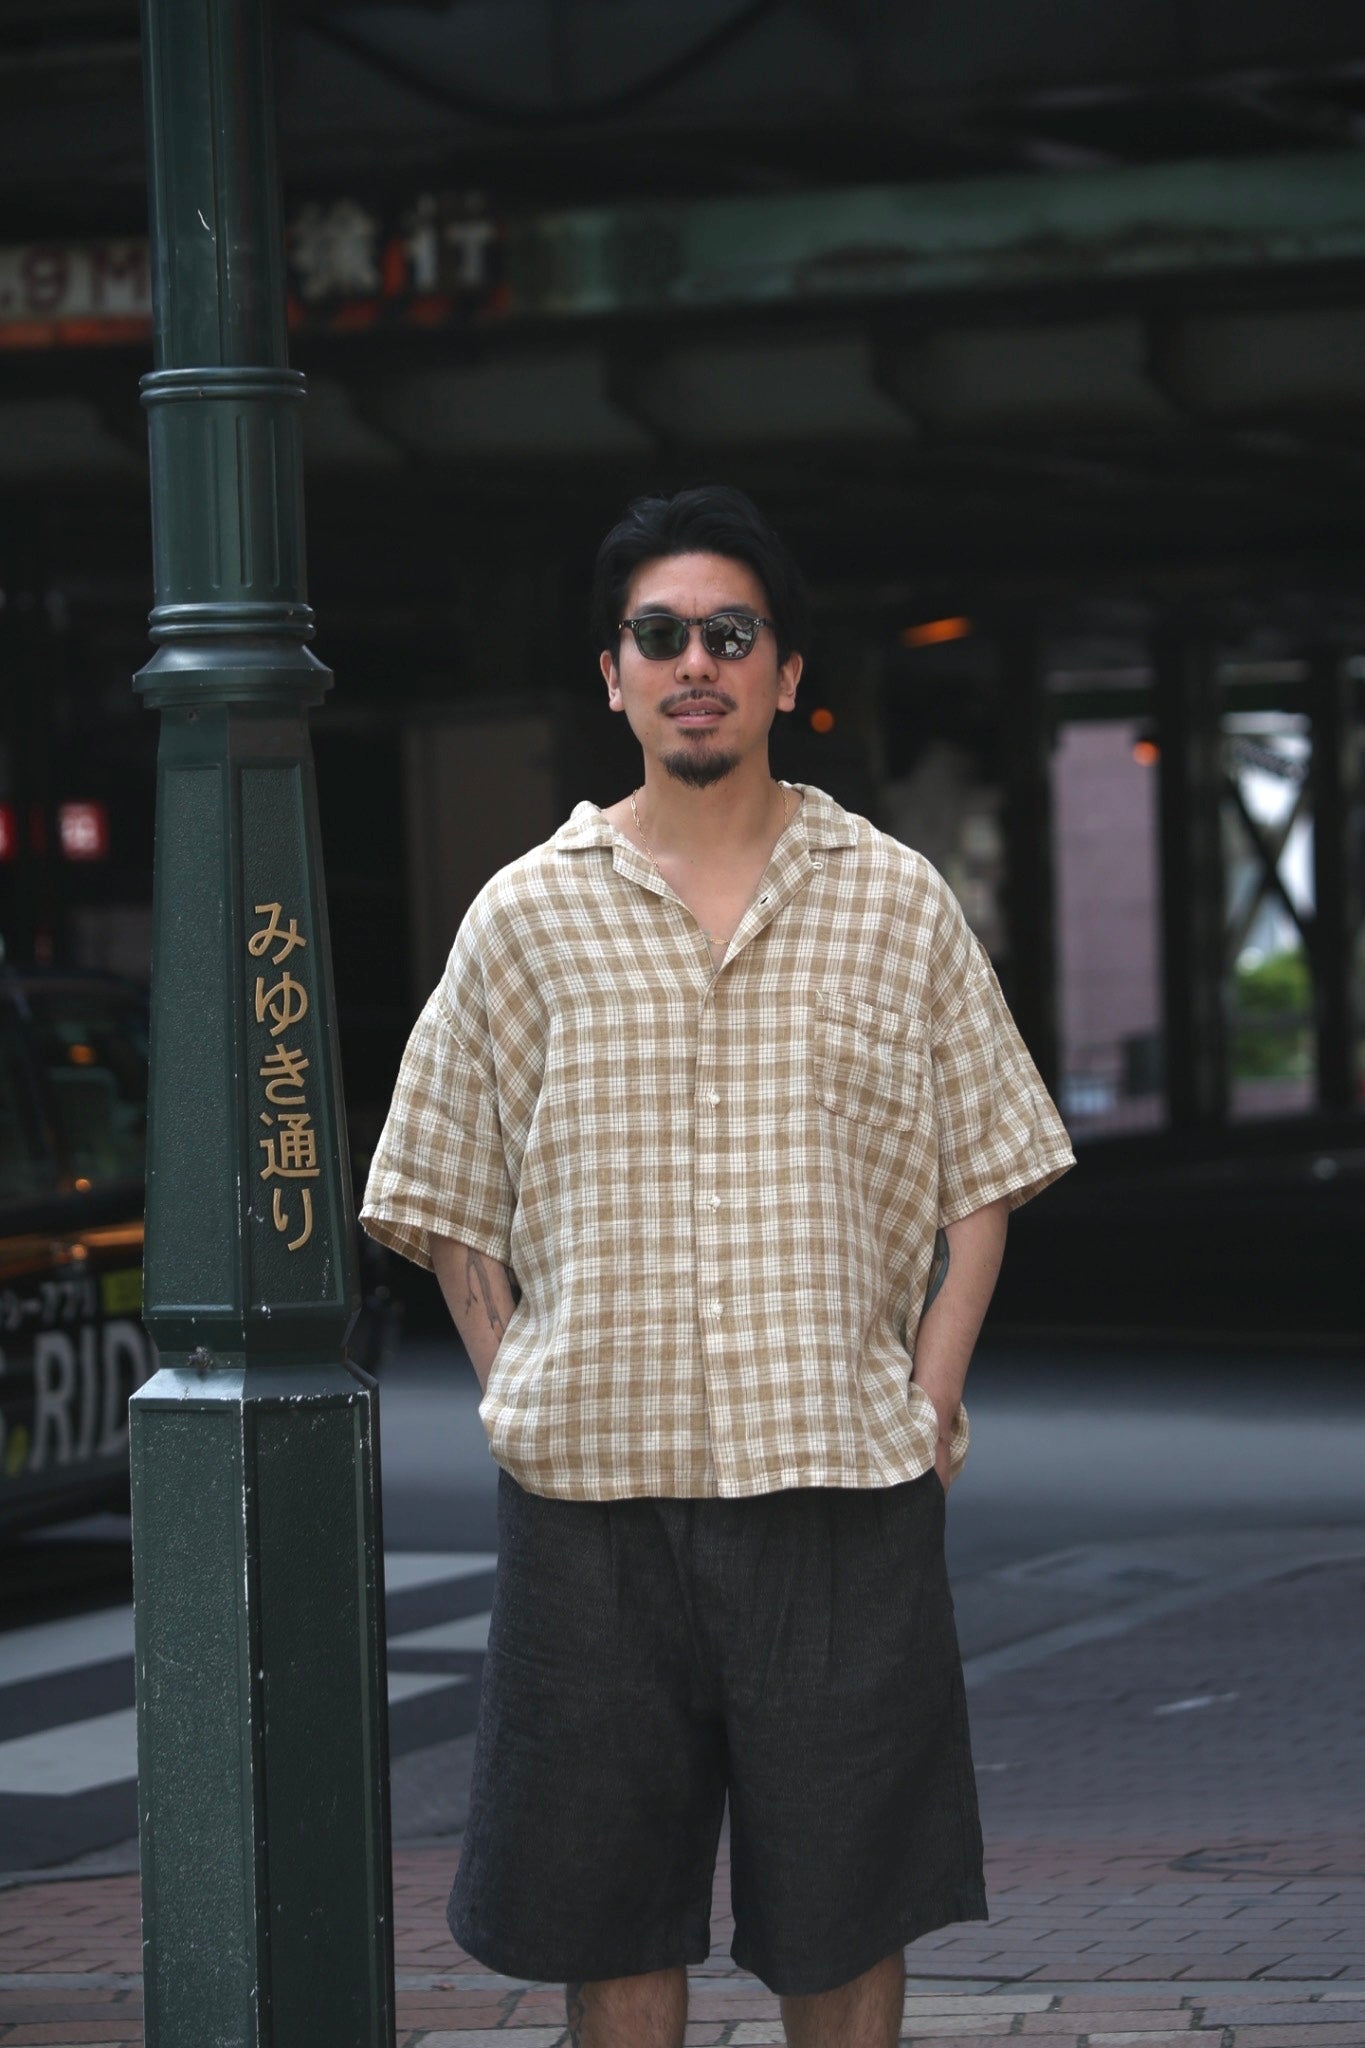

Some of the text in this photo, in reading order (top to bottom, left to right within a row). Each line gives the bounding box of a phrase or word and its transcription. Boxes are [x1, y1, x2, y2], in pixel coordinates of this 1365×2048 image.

[248, 902, 321, 1251] みゆき通り
